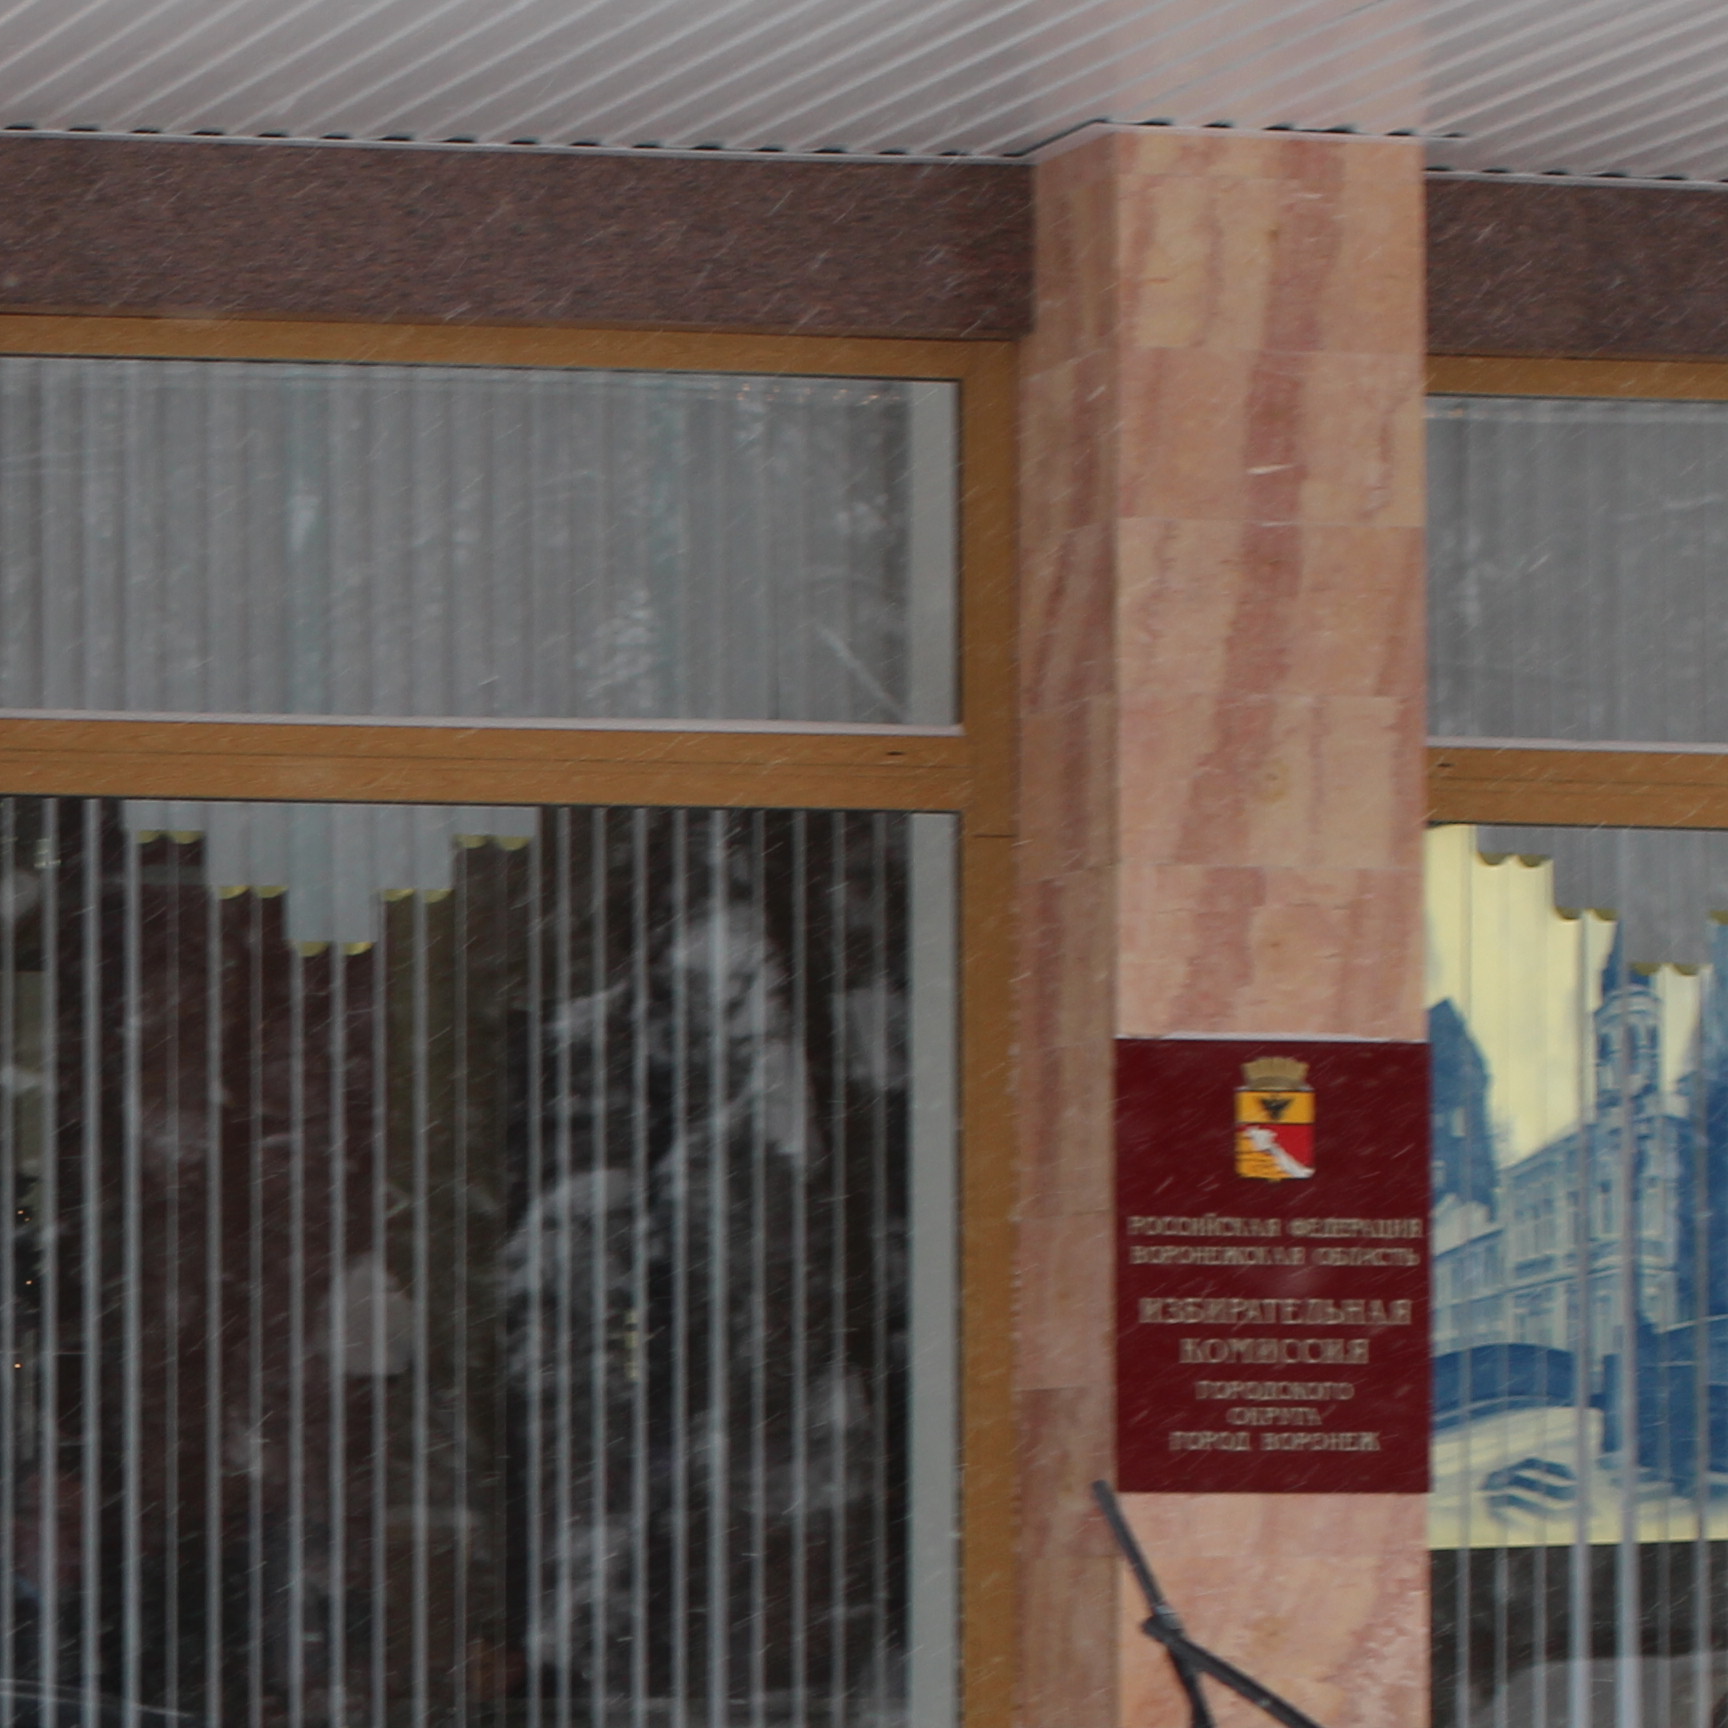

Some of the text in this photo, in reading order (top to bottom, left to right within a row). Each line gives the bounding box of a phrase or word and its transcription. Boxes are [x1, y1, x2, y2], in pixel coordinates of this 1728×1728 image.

[1127, 1213, 1423, 1239] РОССИЙСКАЯ ФЕДЕРАЦИЯ
[1130, 1245, 1421, 1267] ВОРОНЕЖСКАЯ ОБЛАСТЬ
[1139, 1298, 1413, 1325] ИЗБИРАТЕЛЬНАЯ
[1179, 1337, 1370, 1365] КОМИССИЯ
[1195, 1379, 1355, 1402] ГОРОДСКОГО
[1226, 1406, 1323, 1426] ОКРУГА
[1168, 1430, 1382, 1452] ГОРОД ВОРОНЕЖ
